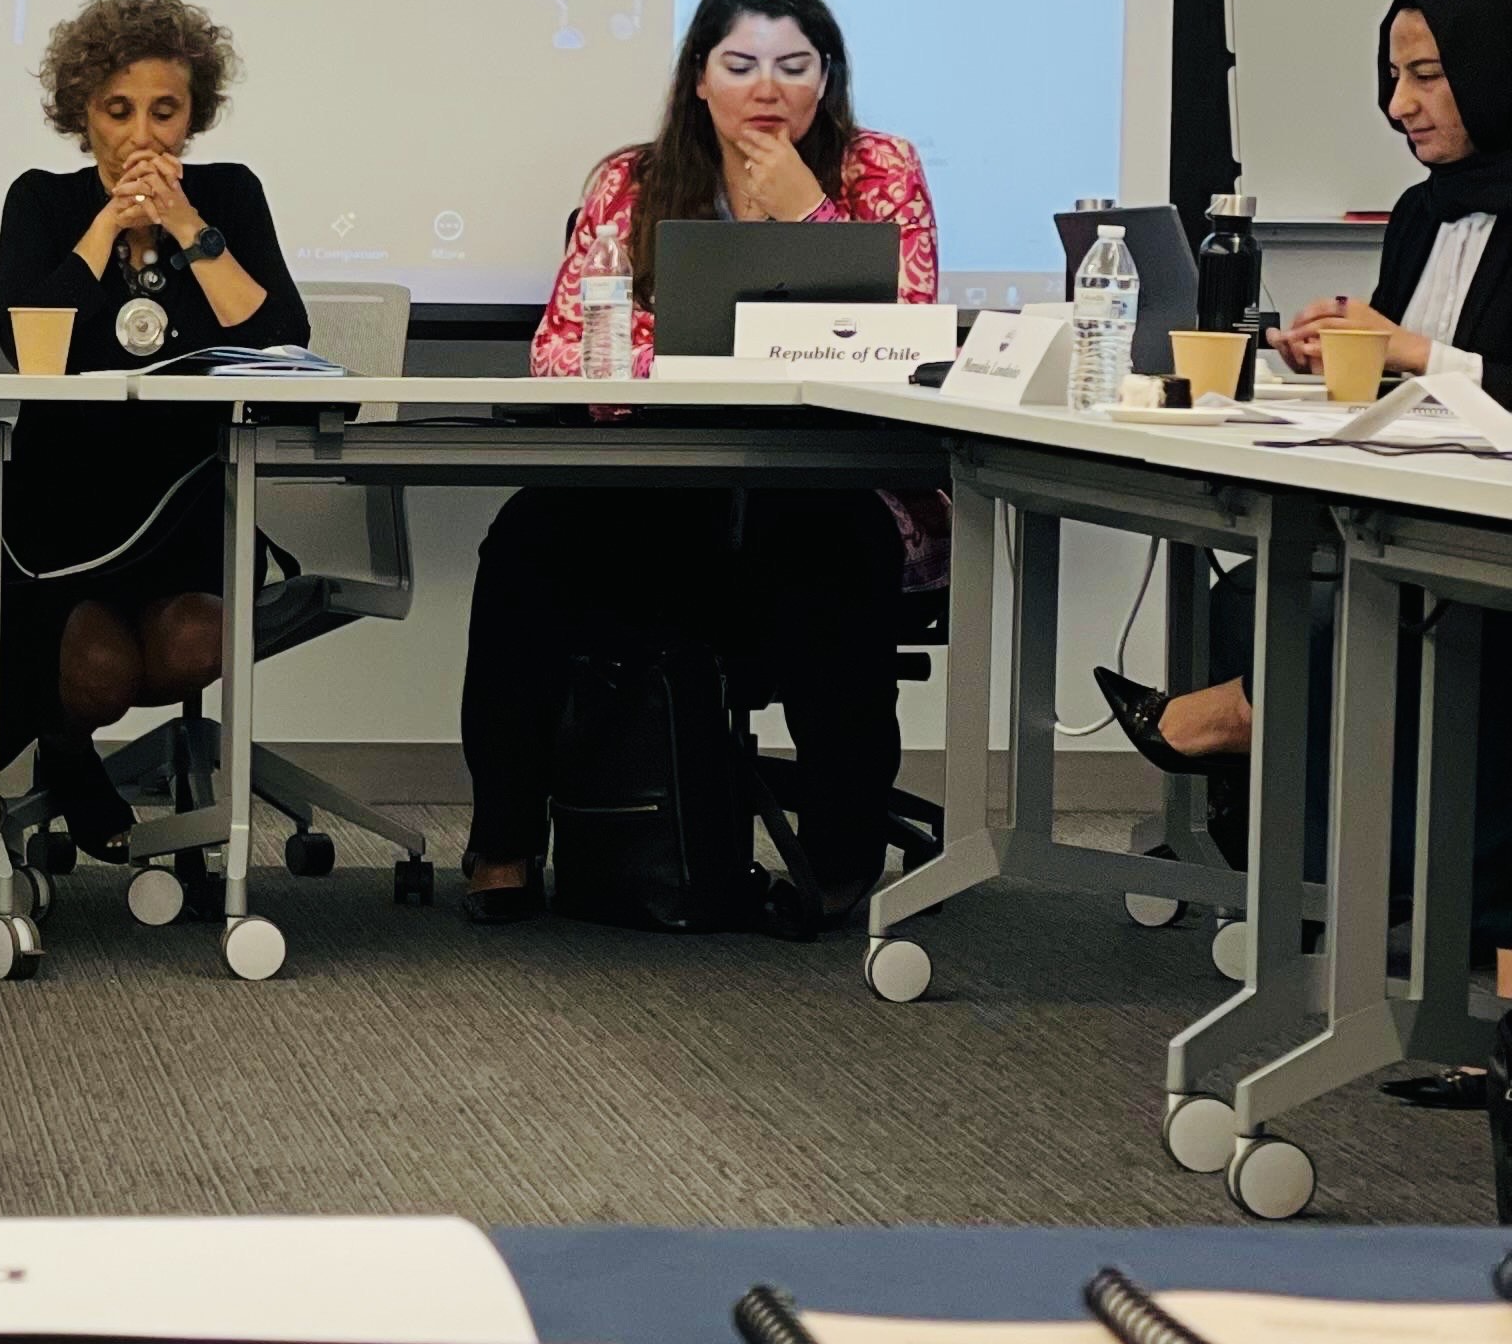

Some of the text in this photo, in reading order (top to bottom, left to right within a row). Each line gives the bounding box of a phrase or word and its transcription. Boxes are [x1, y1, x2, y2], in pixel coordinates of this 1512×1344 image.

[768, 345, 921, 363] Republic of Chile
